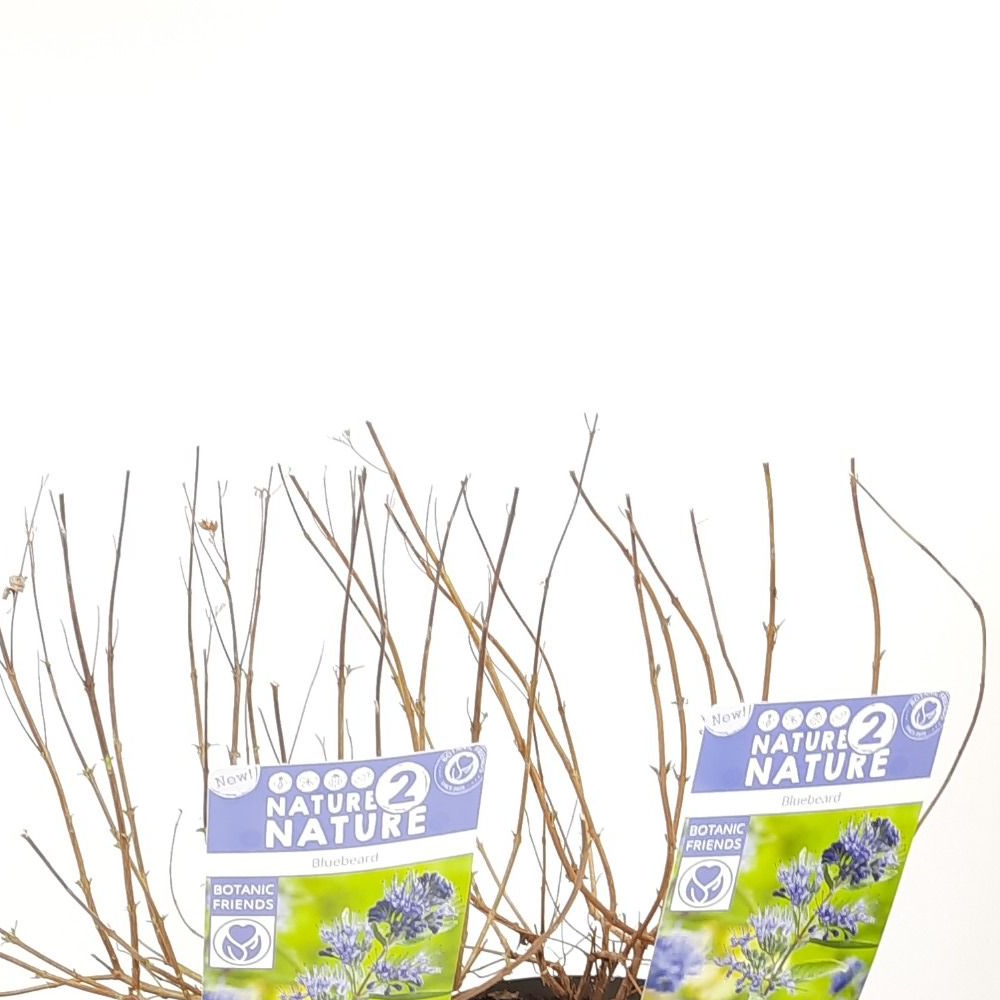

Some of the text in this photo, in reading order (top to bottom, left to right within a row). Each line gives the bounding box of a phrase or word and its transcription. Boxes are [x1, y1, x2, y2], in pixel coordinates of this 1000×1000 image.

[751, 711, 887, 756] NATURE 2
[744, 748, 890, 787] NATURE
[266, 769, 417, 817] NATURE 2
[265, 805, 427, 849] NATURE
[689, 822, 746, 837] BOTANIC
[686, 838, 742, 851] FRIENDS
[212, 884, 275, 897] BOTANIC
[212, 898, 275, 911] FRIENDS
